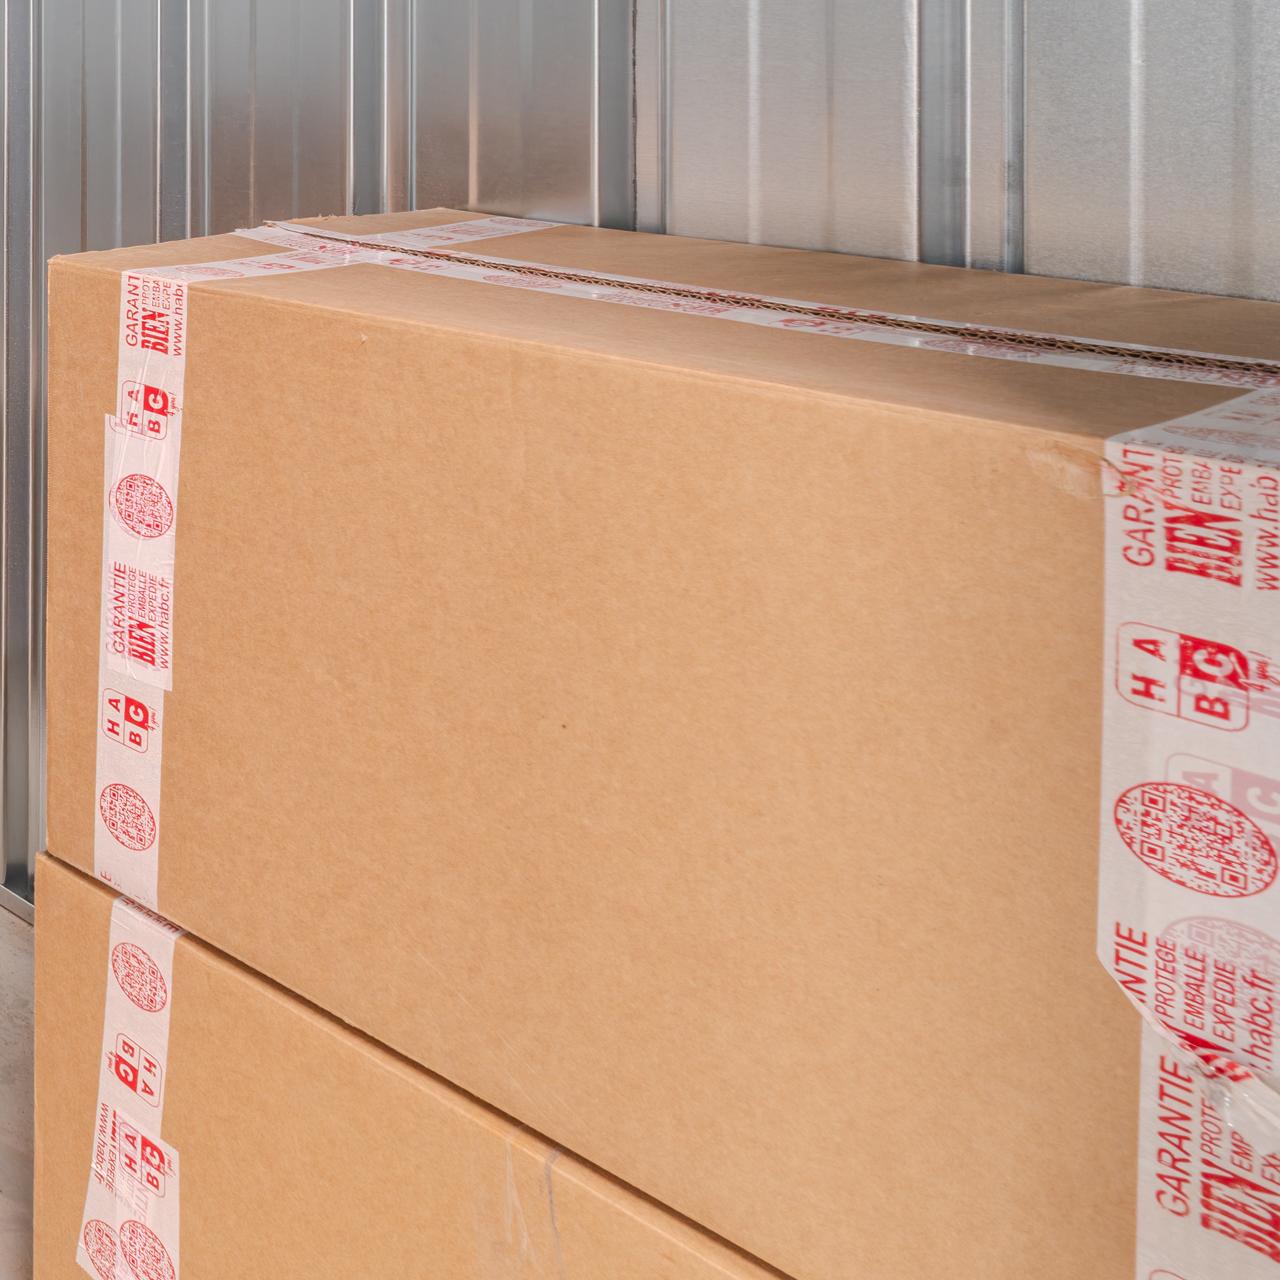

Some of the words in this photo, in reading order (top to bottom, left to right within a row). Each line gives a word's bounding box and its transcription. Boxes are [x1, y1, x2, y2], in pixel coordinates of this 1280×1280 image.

[1164, 501, 1243, 587] BIEN
[112, 561, 126, 654] GARANTIE
[128, 567, 137, 615] PROTEGE
[137, 570, 147, 619] EMBALLE
[148, 574, 158, 622] EXPEDIE
[158, 577, 171, 669] www.habc.fr
[128, 616, 156, 666] BIEN
[1154, 935, 1177, 1018] PROTEGE
[1183, 946, 1207, 1031] EMBALLE
[1212, 958, 1236, 1044] EXPEDIE
[1155, 1055, 1196, 1218] GARANTIE
